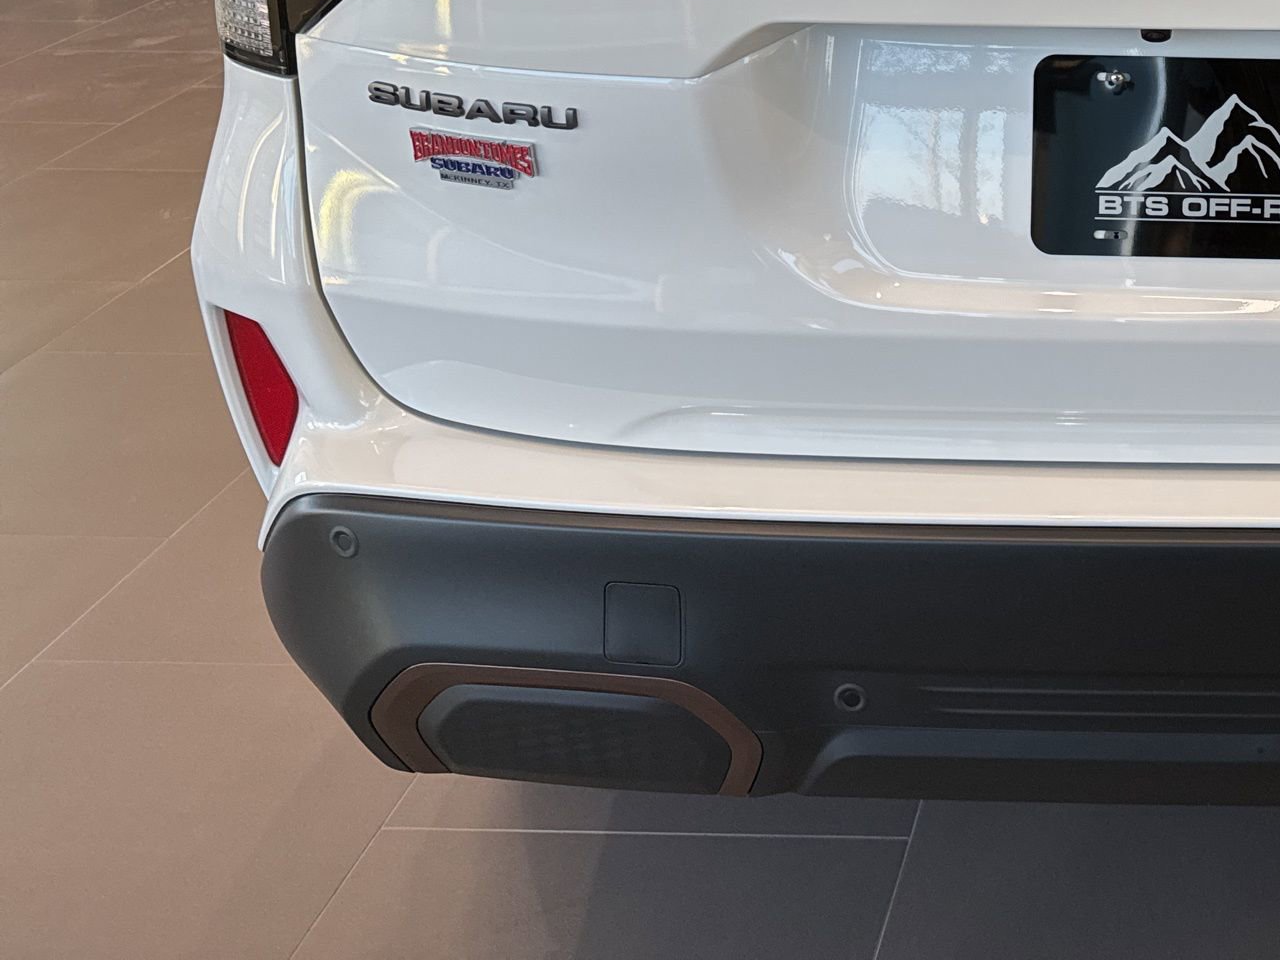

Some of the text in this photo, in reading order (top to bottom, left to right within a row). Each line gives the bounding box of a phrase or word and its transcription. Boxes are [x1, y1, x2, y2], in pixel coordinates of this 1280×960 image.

[367, 80, 579, 130] SUBARU
[430, 156, 515, 180] SUBARU
[1098, 195, 1169, 217] BTS
